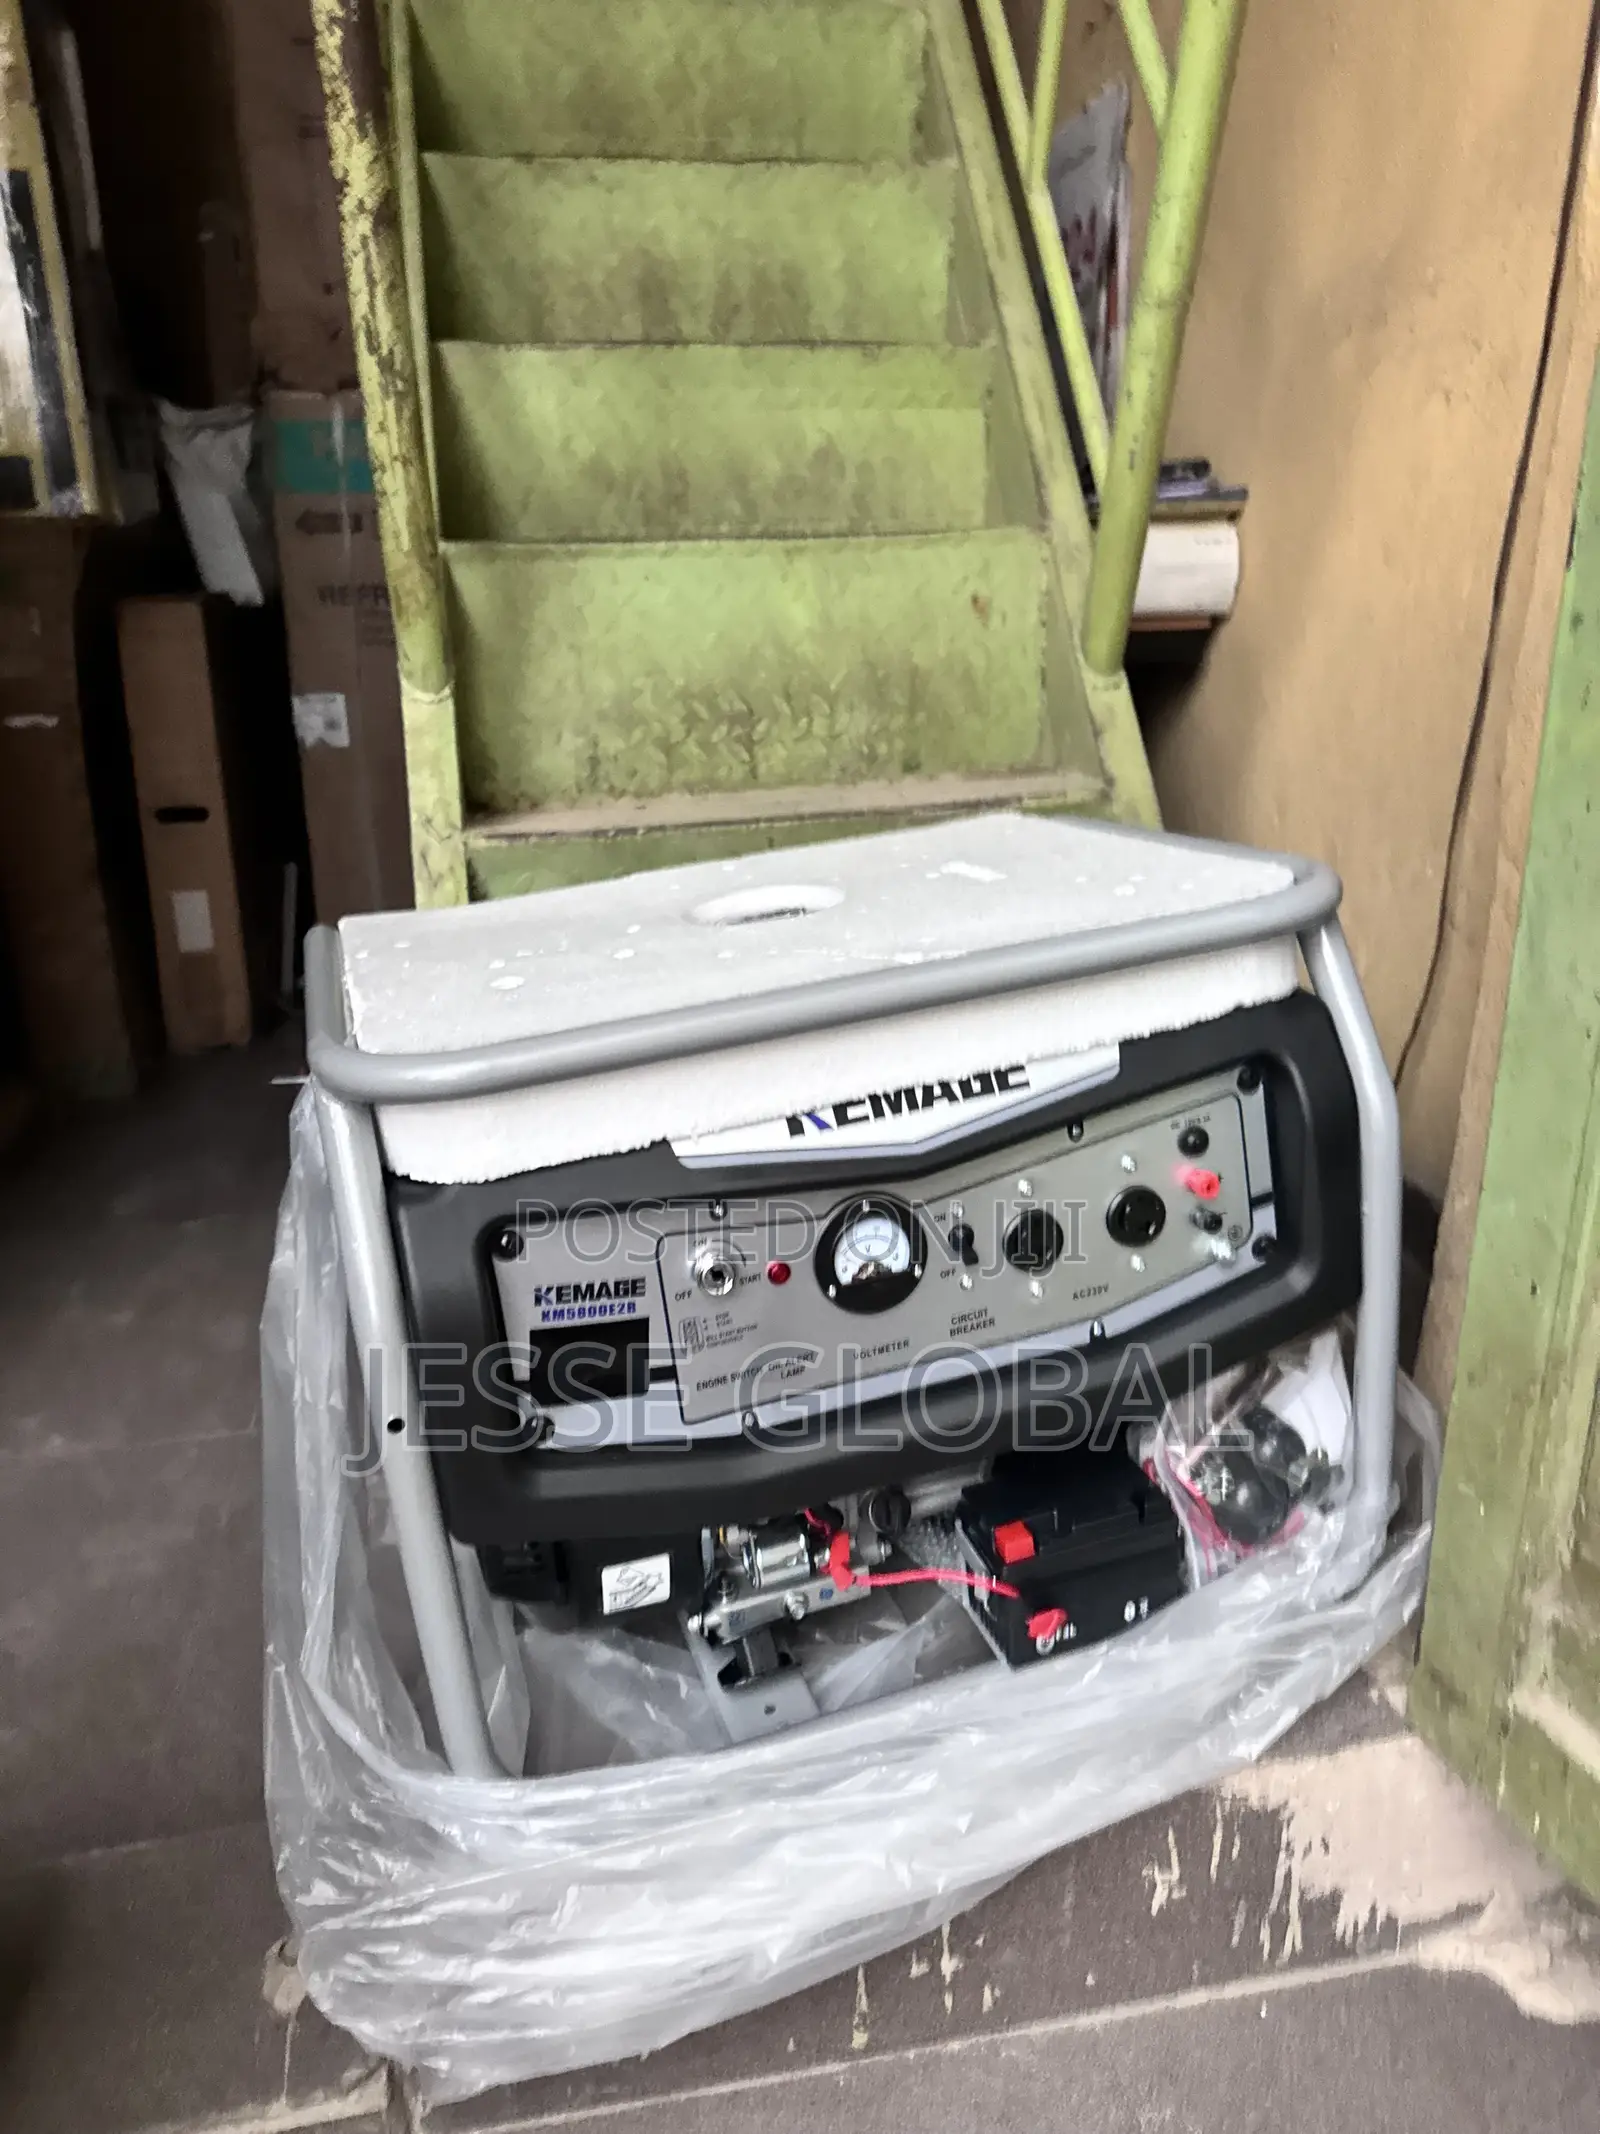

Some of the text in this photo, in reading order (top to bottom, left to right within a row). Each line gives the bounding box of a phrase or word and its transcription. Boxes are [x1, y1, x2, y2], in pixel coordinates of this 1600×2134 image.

[739, 1272, 762, 1286] START
[939, 1268, 957, 1280] OFF
[534, 1276, 647, 1307] KEMAGE
[674, 1289, 693, 1302] OFF
[950, 1308, 988, 1326] CIRCUIT
[950, 1317, 996, 1338] BREAKER
[780, 1365, 806, 1380] LAMP
[696, 1375, 729, 1392] ENGINE
